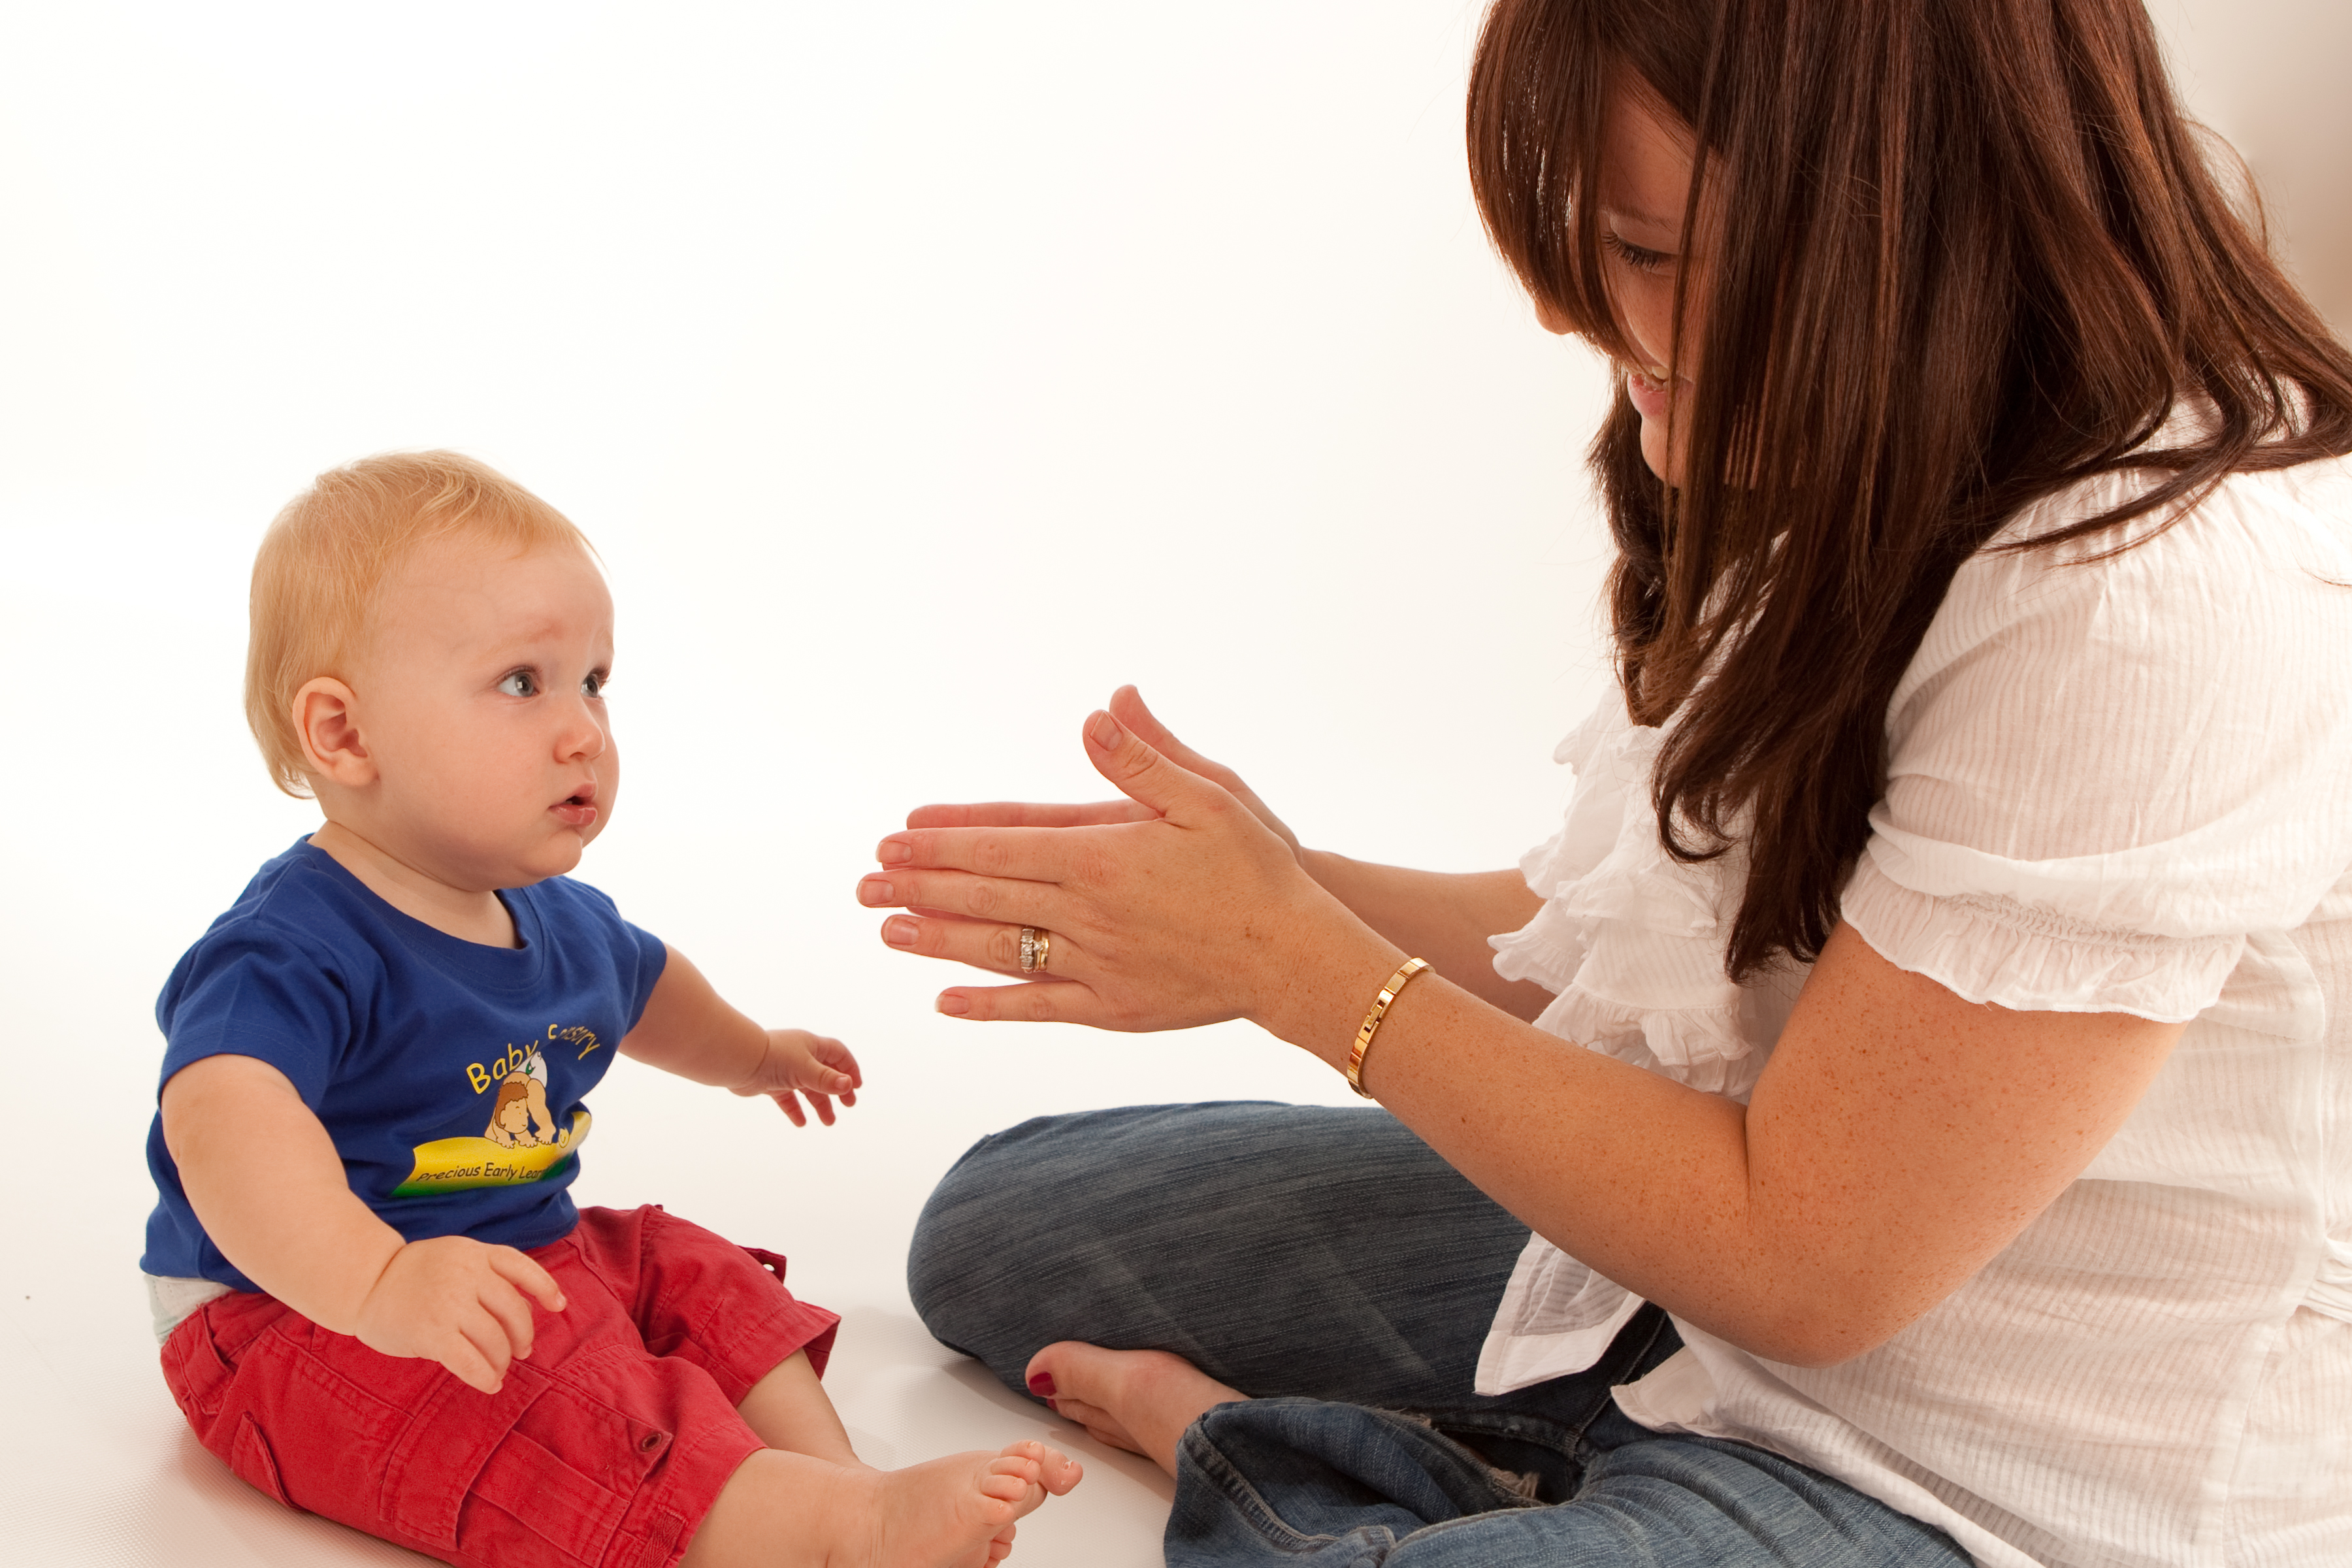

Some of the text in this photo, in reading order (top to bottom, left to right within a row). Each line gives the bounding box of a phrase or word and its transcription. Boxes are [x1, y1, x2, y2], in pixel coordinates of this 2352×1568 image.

[466, 1039, 539, 1094] Baby
[416, 1162, 544, 1182] Precious Early Lear
